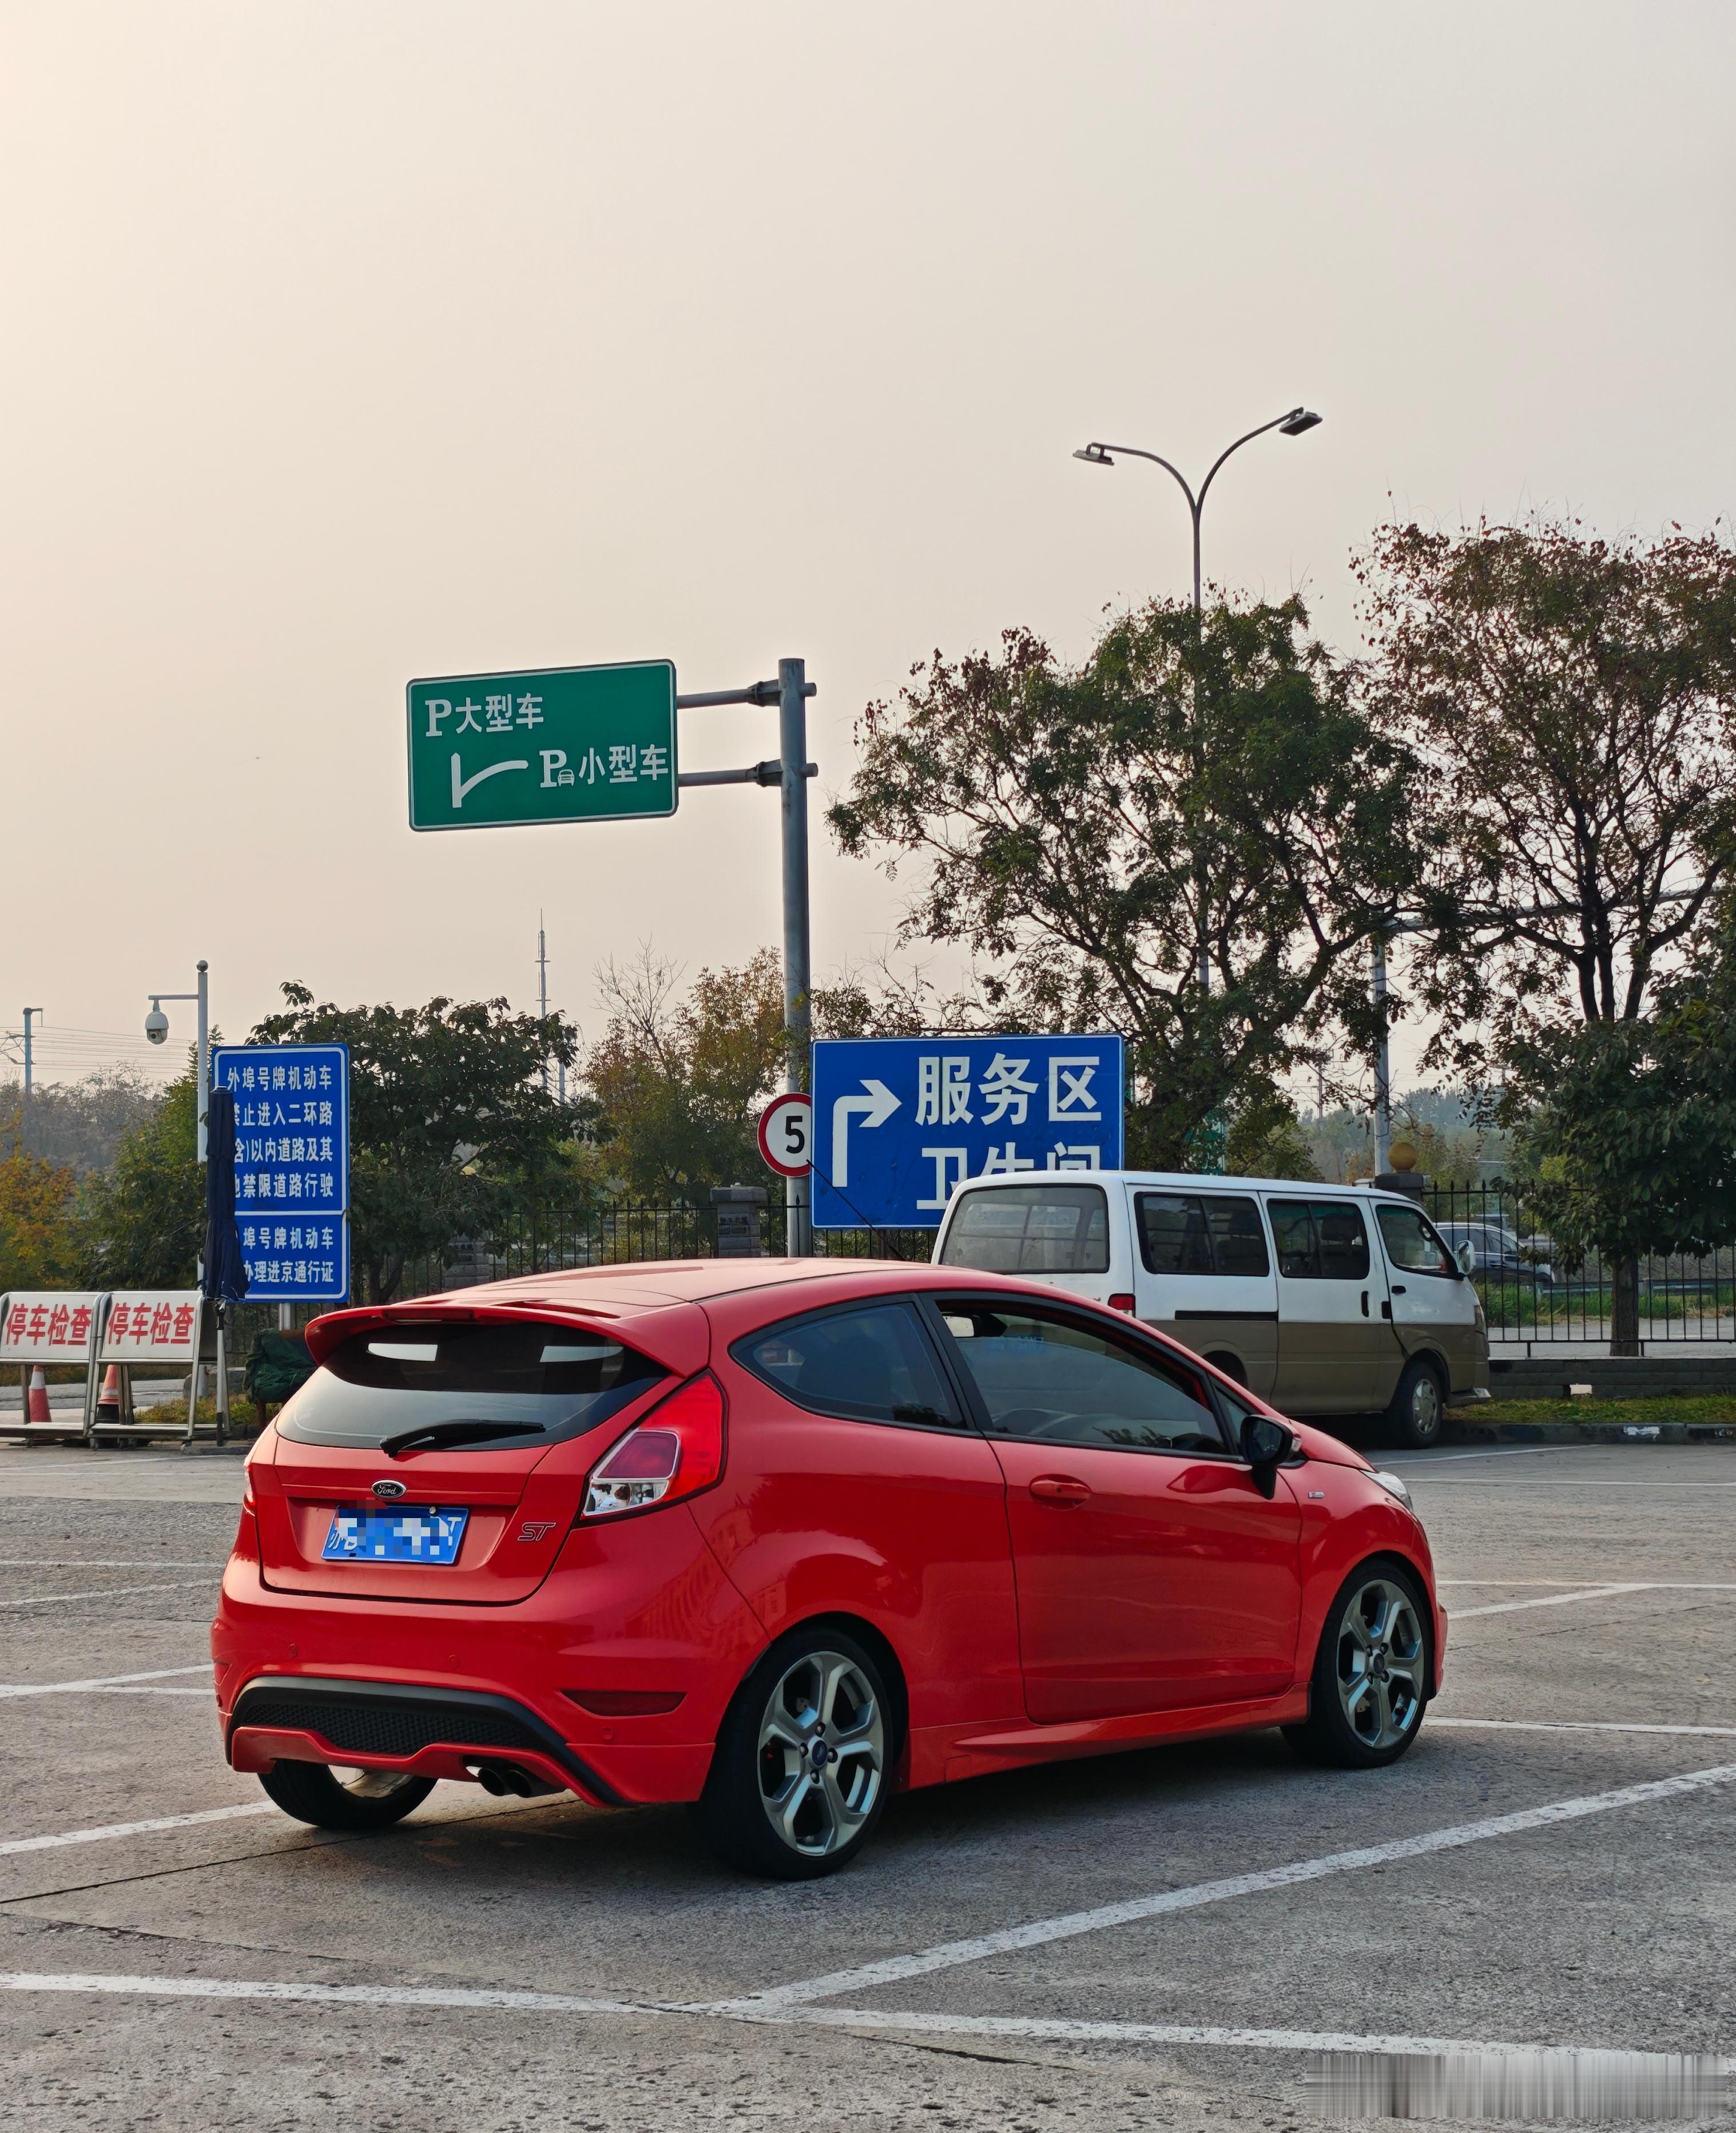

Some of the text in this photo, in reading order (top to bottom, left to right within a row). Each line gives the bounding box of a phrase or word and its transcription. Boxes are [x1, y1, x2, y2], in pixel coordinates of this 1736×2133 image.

[579, 744, 668, 784] 小型车
[227, 1065, 332, 1092] 外埠号牌机动车
[915, 1053, 1101, 1125] 服务区
[785, 1116, 805, 1154] 5
[7, 1304, 92, 1345] 停车检查
[109, 1302, 194, 1344] 停车检查
[378, 1483, 396, 1495] Ford
[517, 1522, 556, 1541] ST
